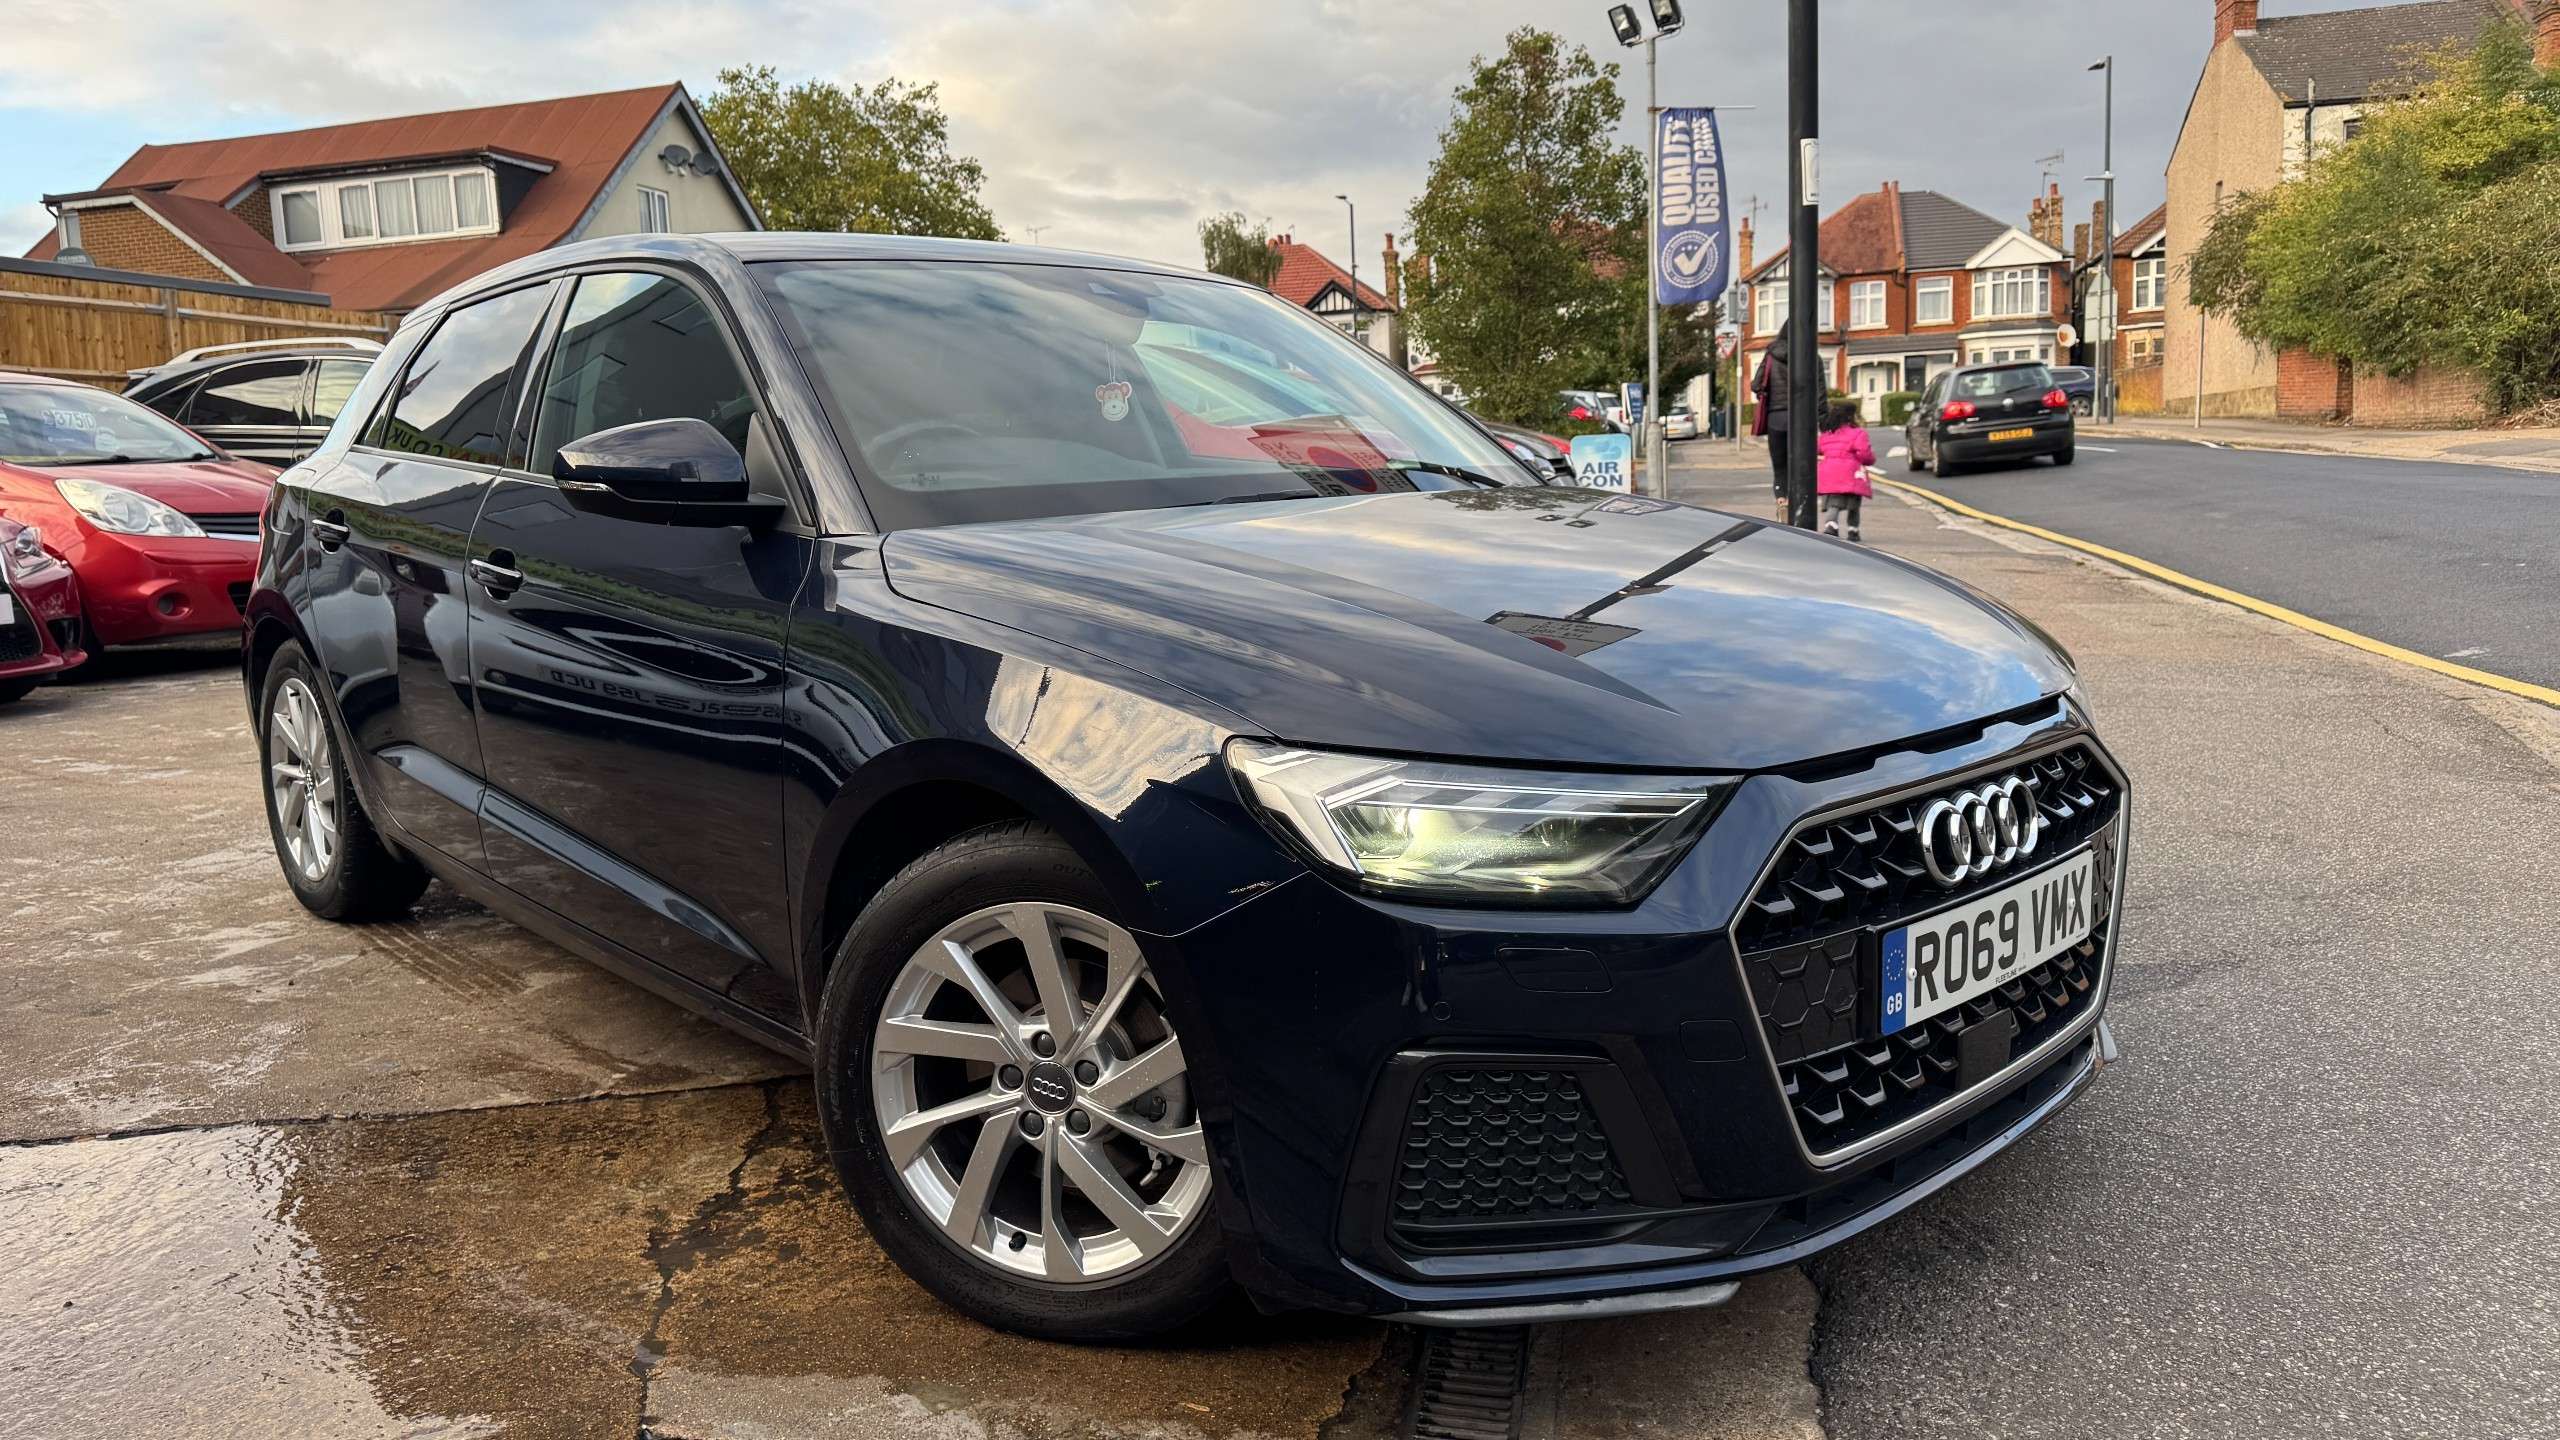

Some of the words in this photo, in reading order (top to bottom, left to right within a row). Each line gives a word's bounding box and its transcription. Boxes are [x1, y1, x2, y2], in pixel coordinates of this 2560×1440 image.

[1691, 117, 1717, 164] CARS
[1662, 116, 1695, 226] QUALITY
[1695, 167, 1720, 224] USED
[1579, 474, 1623, 488] CON
[1582, 461, 1619, 475] AIR
[1913, 899, 2019, 1009] RO69
[2031, 864, 2087, 954] VMX
[1886, 992, 1903, 1015] GB
